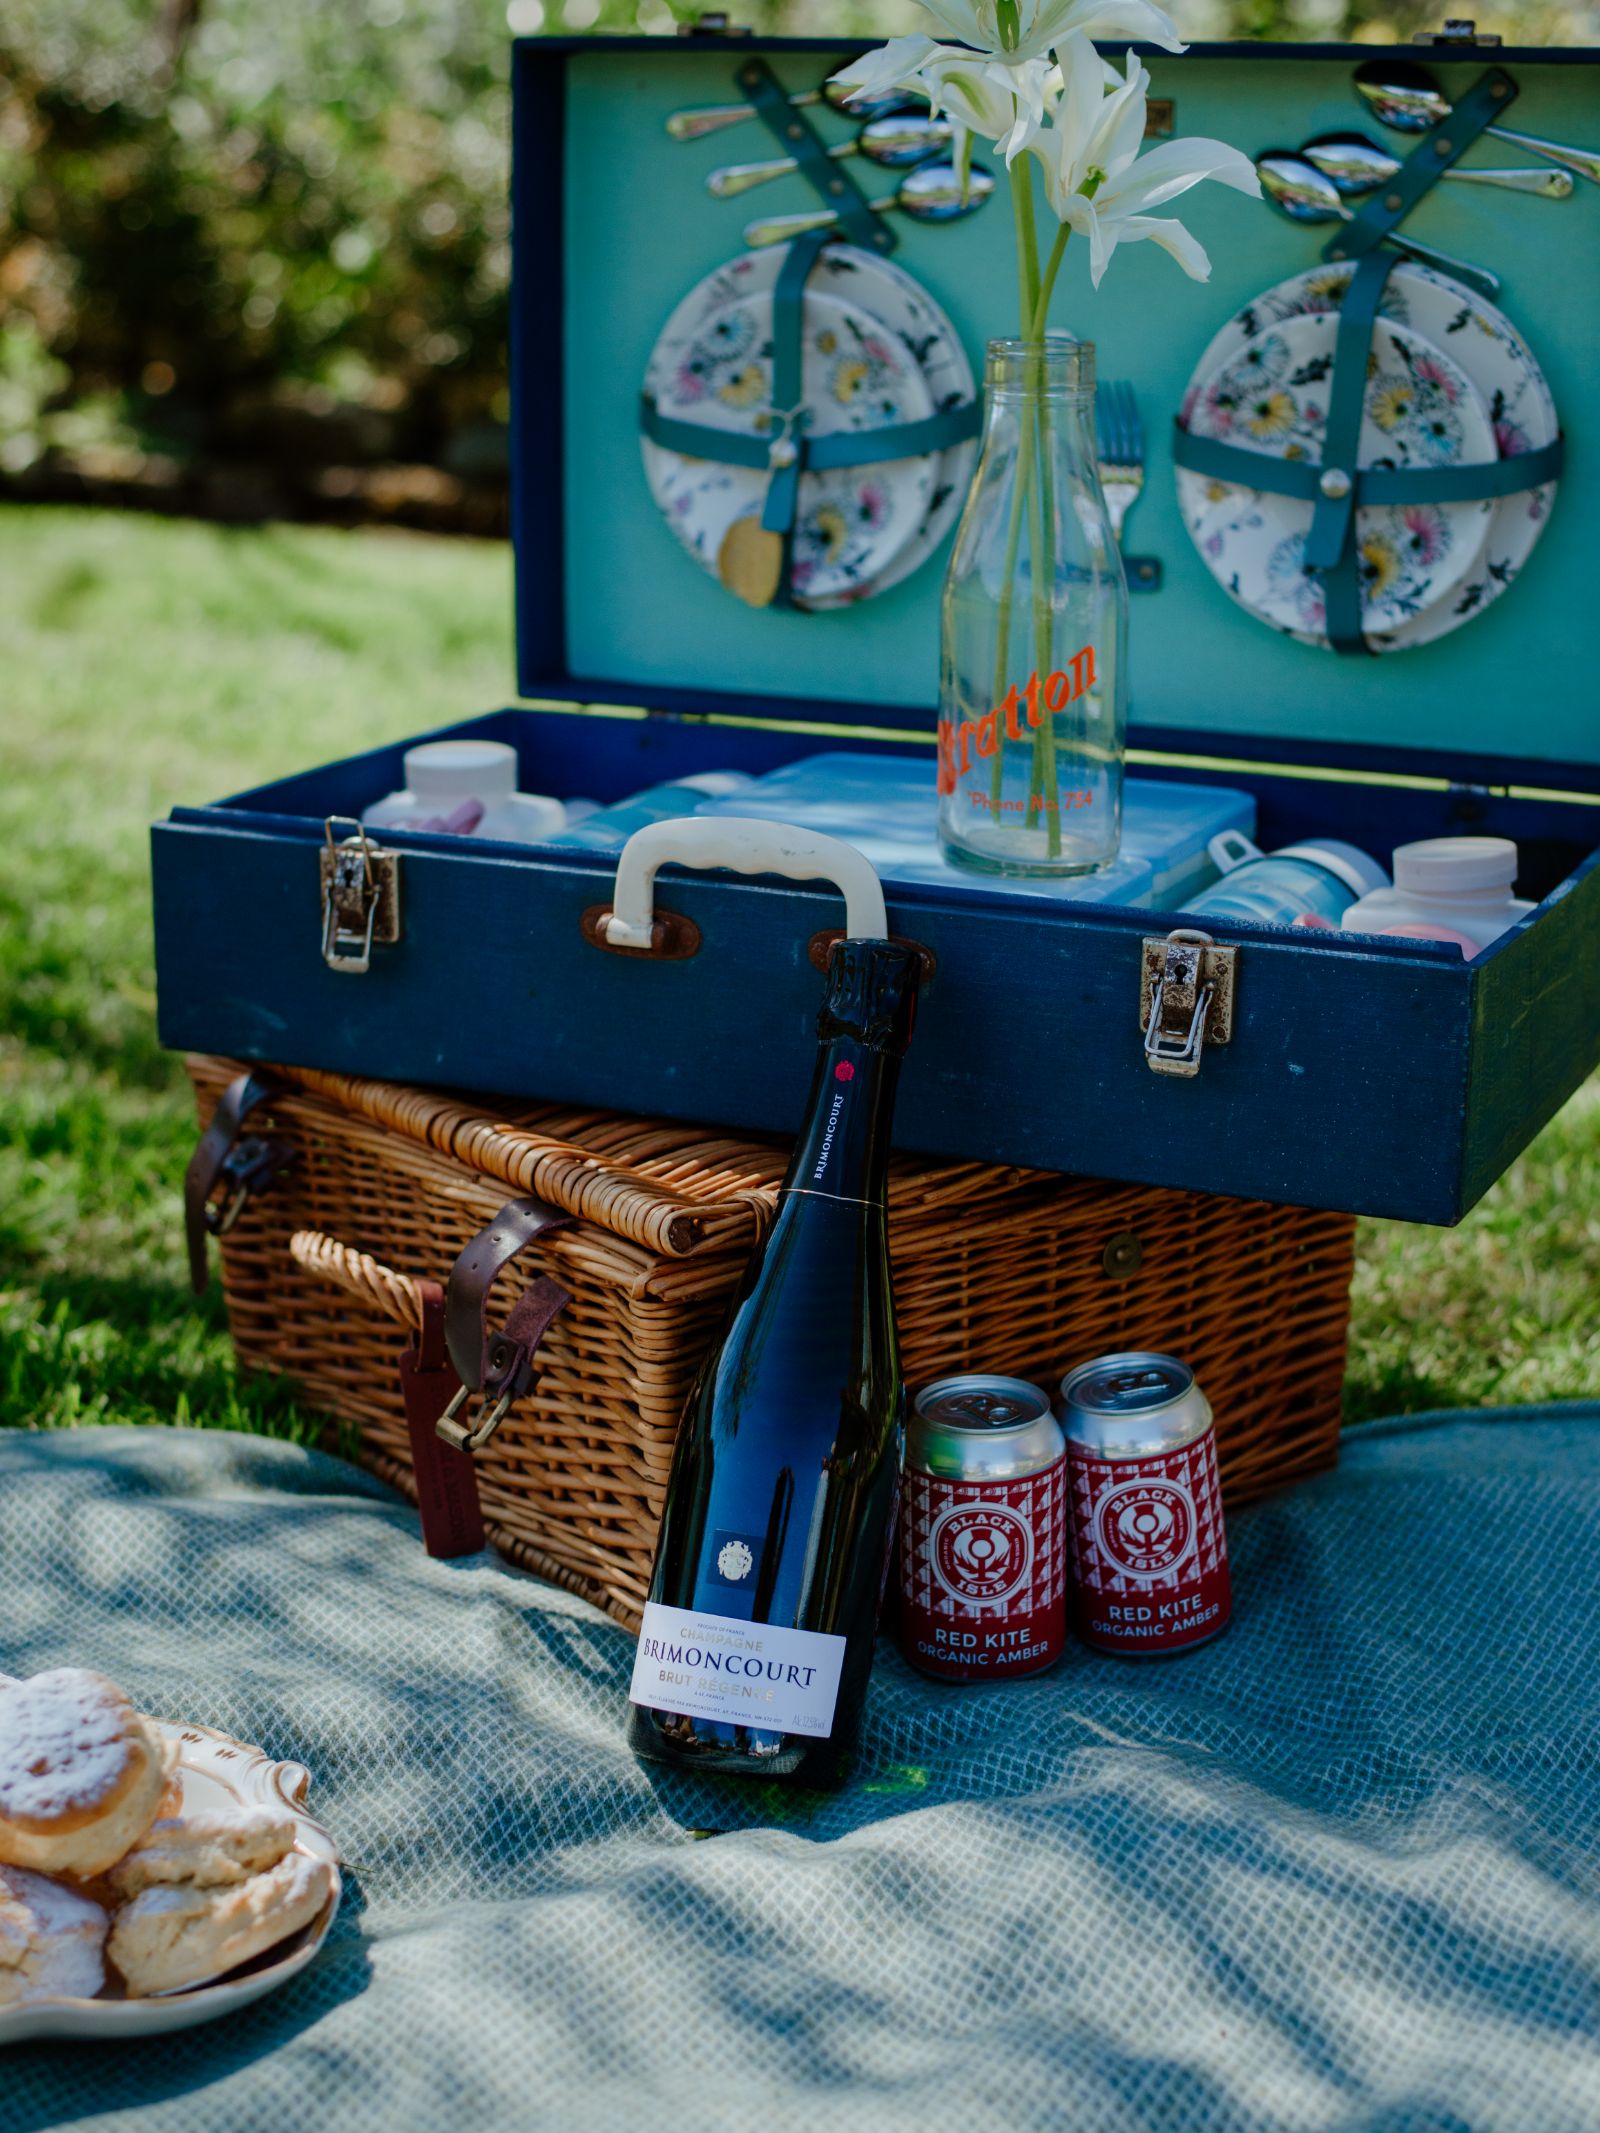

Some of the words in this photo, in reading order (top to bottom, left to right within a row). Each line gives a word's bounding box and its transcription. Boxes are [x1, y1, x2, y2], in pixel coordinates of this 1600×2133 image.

[1063, 789, 1093, 810] 754
[813, 1093, 844, 1180] BRIMONCOURT
[1111, 1489, 1176, 1514] BLACK
[948, 1513, 1015, 1535] BLACK
[1125, 1550, 1176, 1570] ISLE
[956, 1580, 1008, 1596] ISLE
[1092, 1619, 1165, 1637] ORGANIC
[1171, 1602, 1220, 1633] AMBER
[1109, 1605, 1151, 1622] RED
[1159, 1593, 1204, 1619] KITE
[680, 1628, 764, 1652] CHAMPAGNE
[935, 1628, 977, 1648] RED
[985, 1628, 1031, 1648] KITE
[644, 1638, 817, 1690] BRIMONCOURT
[918, 1641, 989, 1665] ORGANIC
[995, 1640, 1048, 1664] AMBER
[659, 1669, 693, 1687] BRUT
